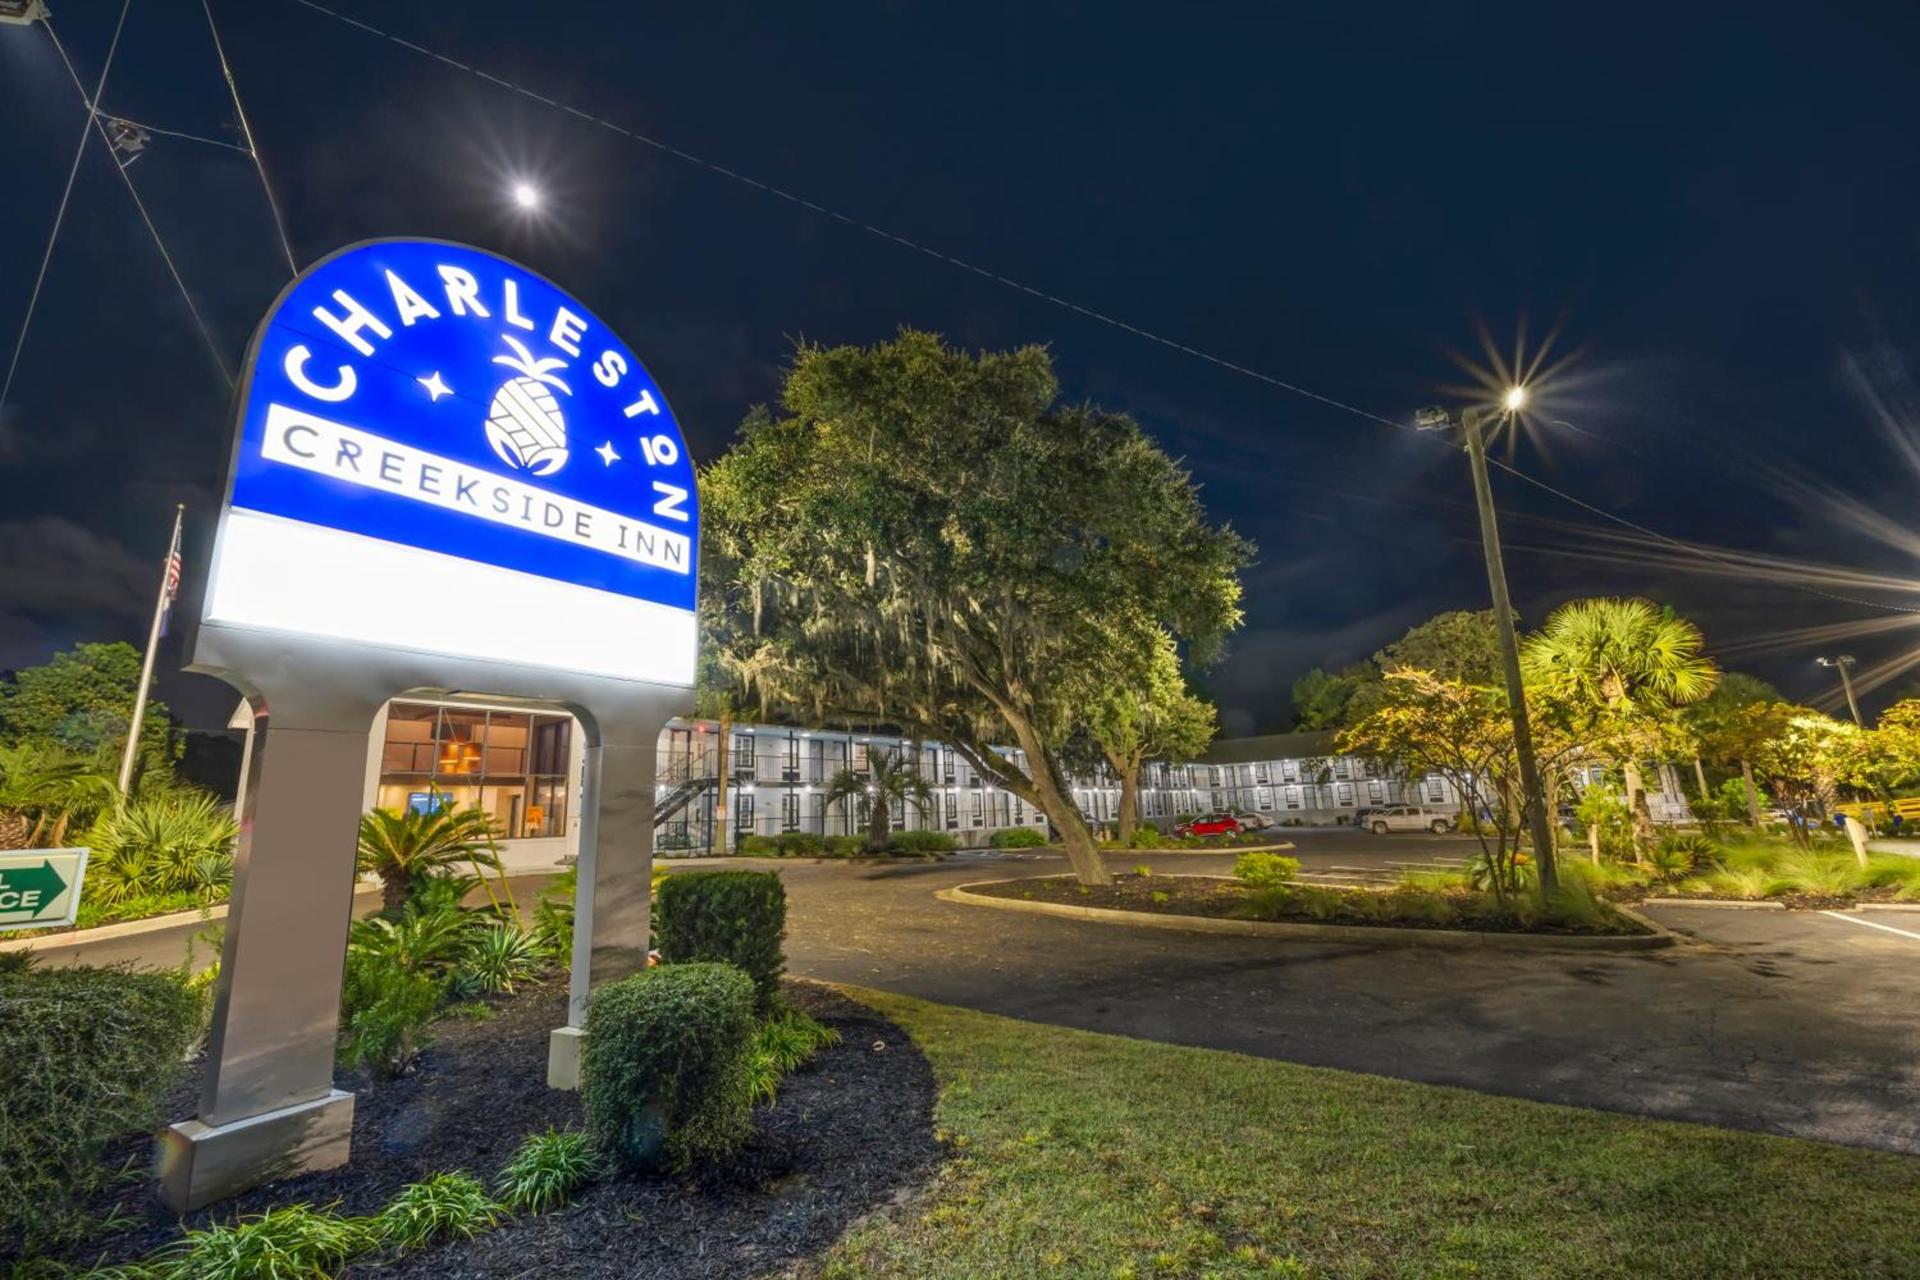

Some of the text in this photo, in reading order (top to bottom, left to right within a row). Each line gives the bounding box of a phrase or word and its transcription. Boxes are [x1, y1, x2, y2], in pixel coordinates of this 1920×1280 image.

[284, 264, 689, 522] CHARLESTON
[283, 424, 681, 565] CREEKSIDE INN
